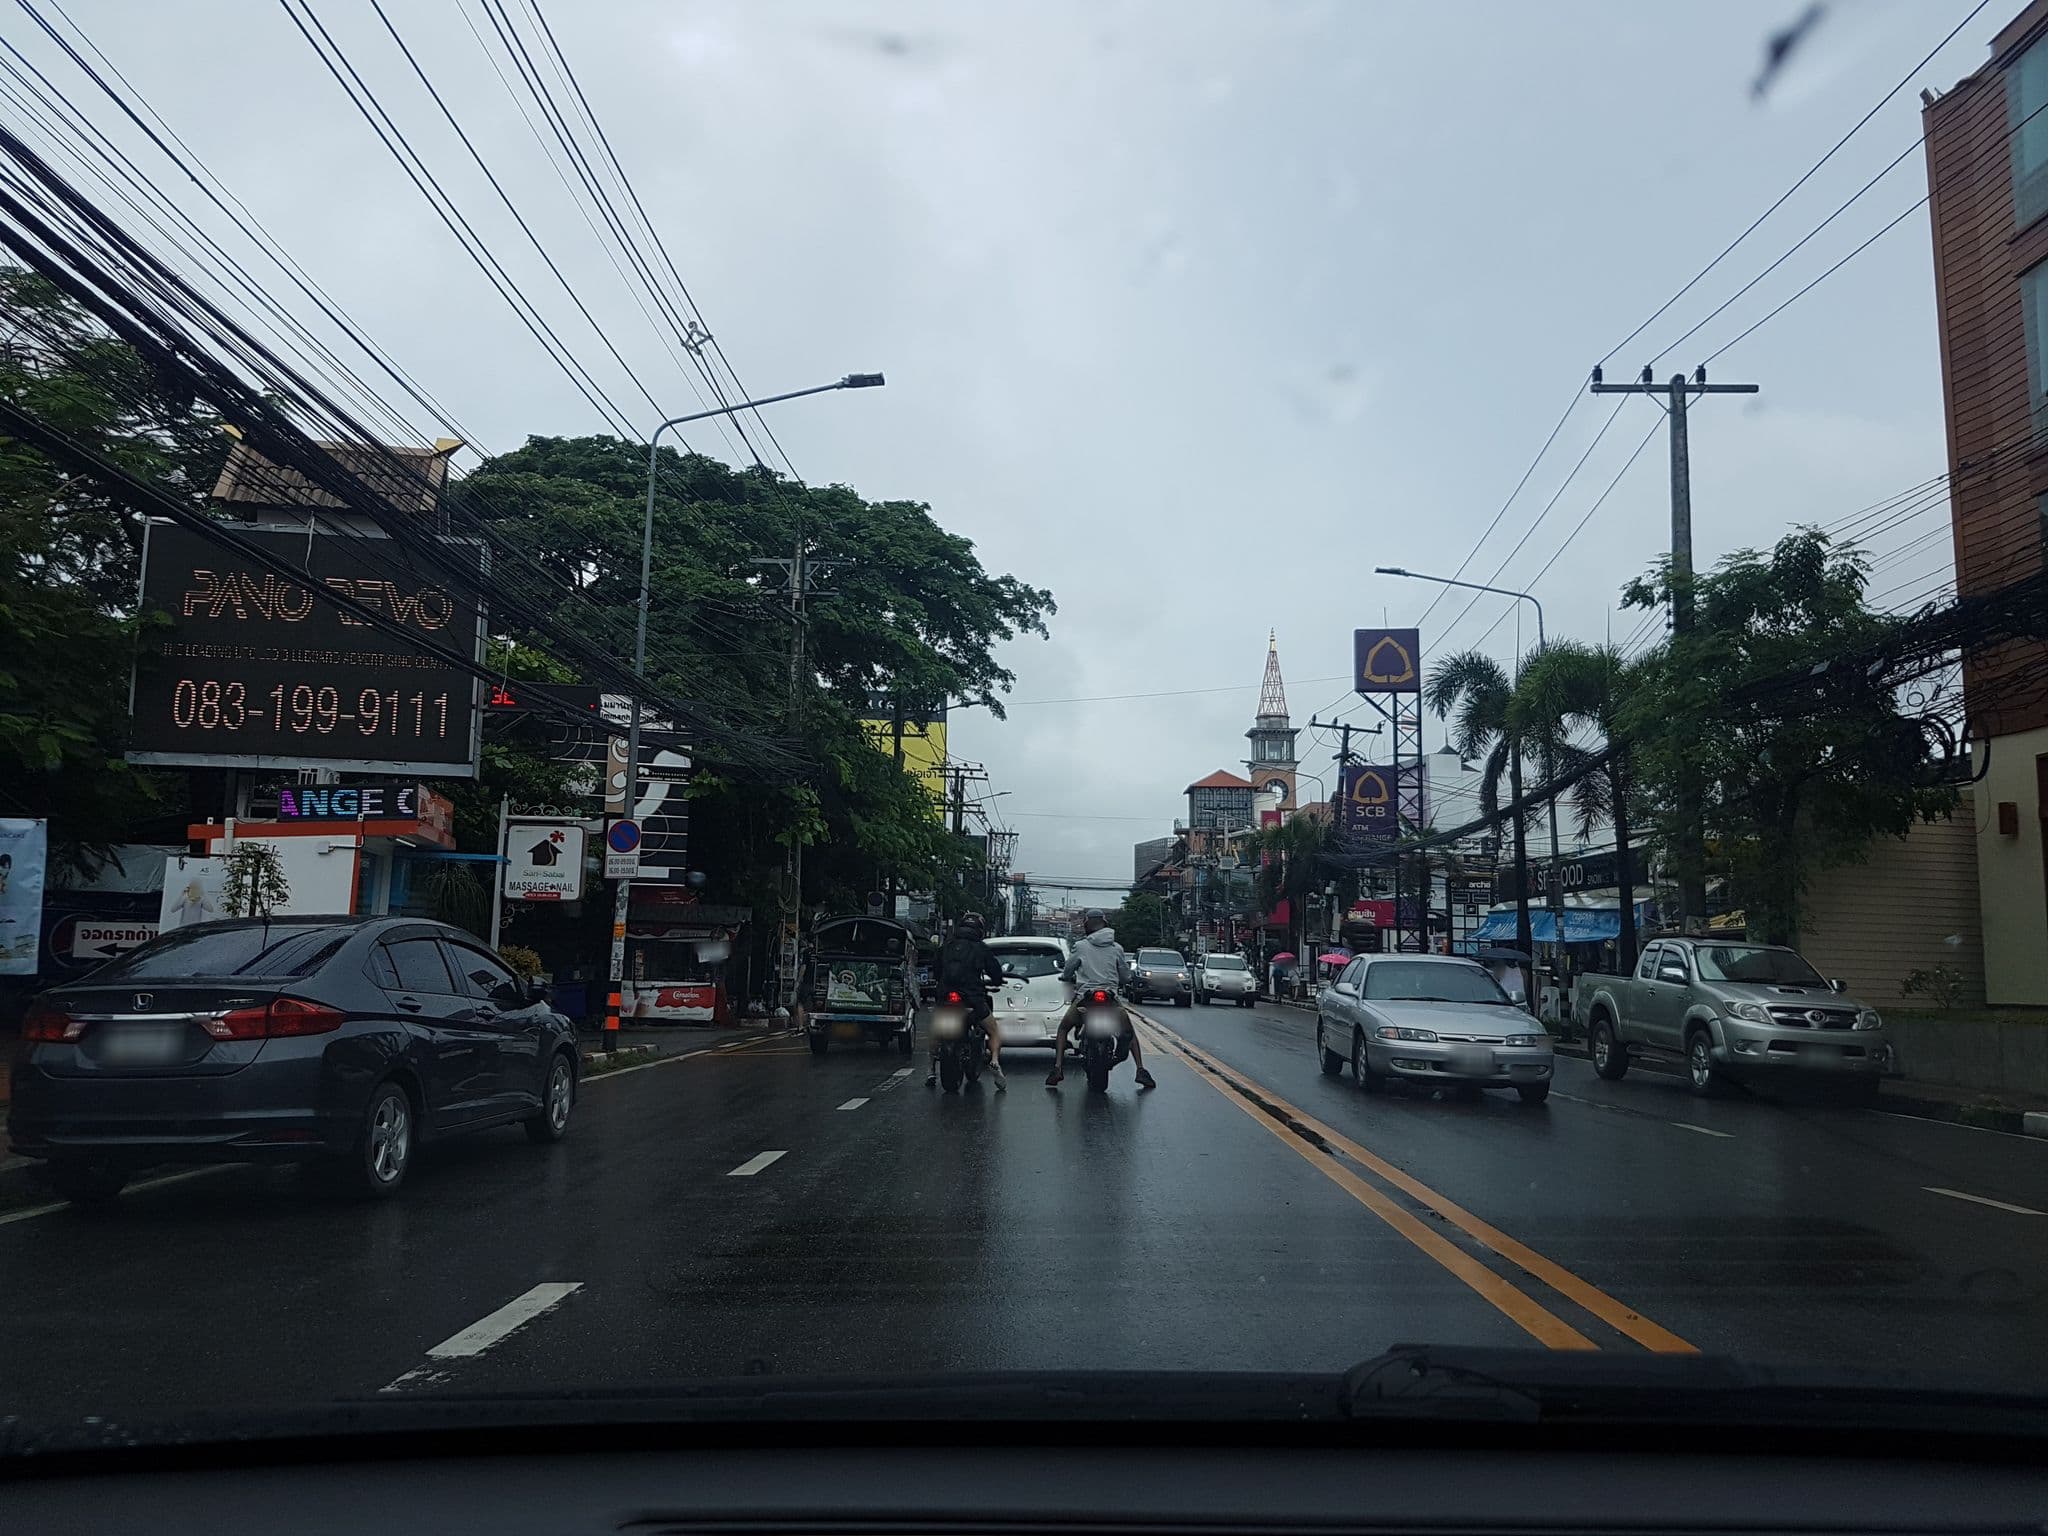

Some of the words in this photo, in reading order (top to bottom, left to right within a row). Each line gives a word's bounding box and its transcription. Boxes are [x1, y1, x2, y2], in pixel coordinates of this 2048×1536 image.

[182, 568, 314, 623] PANO
[172, 679, 449, 738] 083-199-9111
[1351, 824, 1369, 832] ATM
[1355, 806, 1386, 817] SCB
